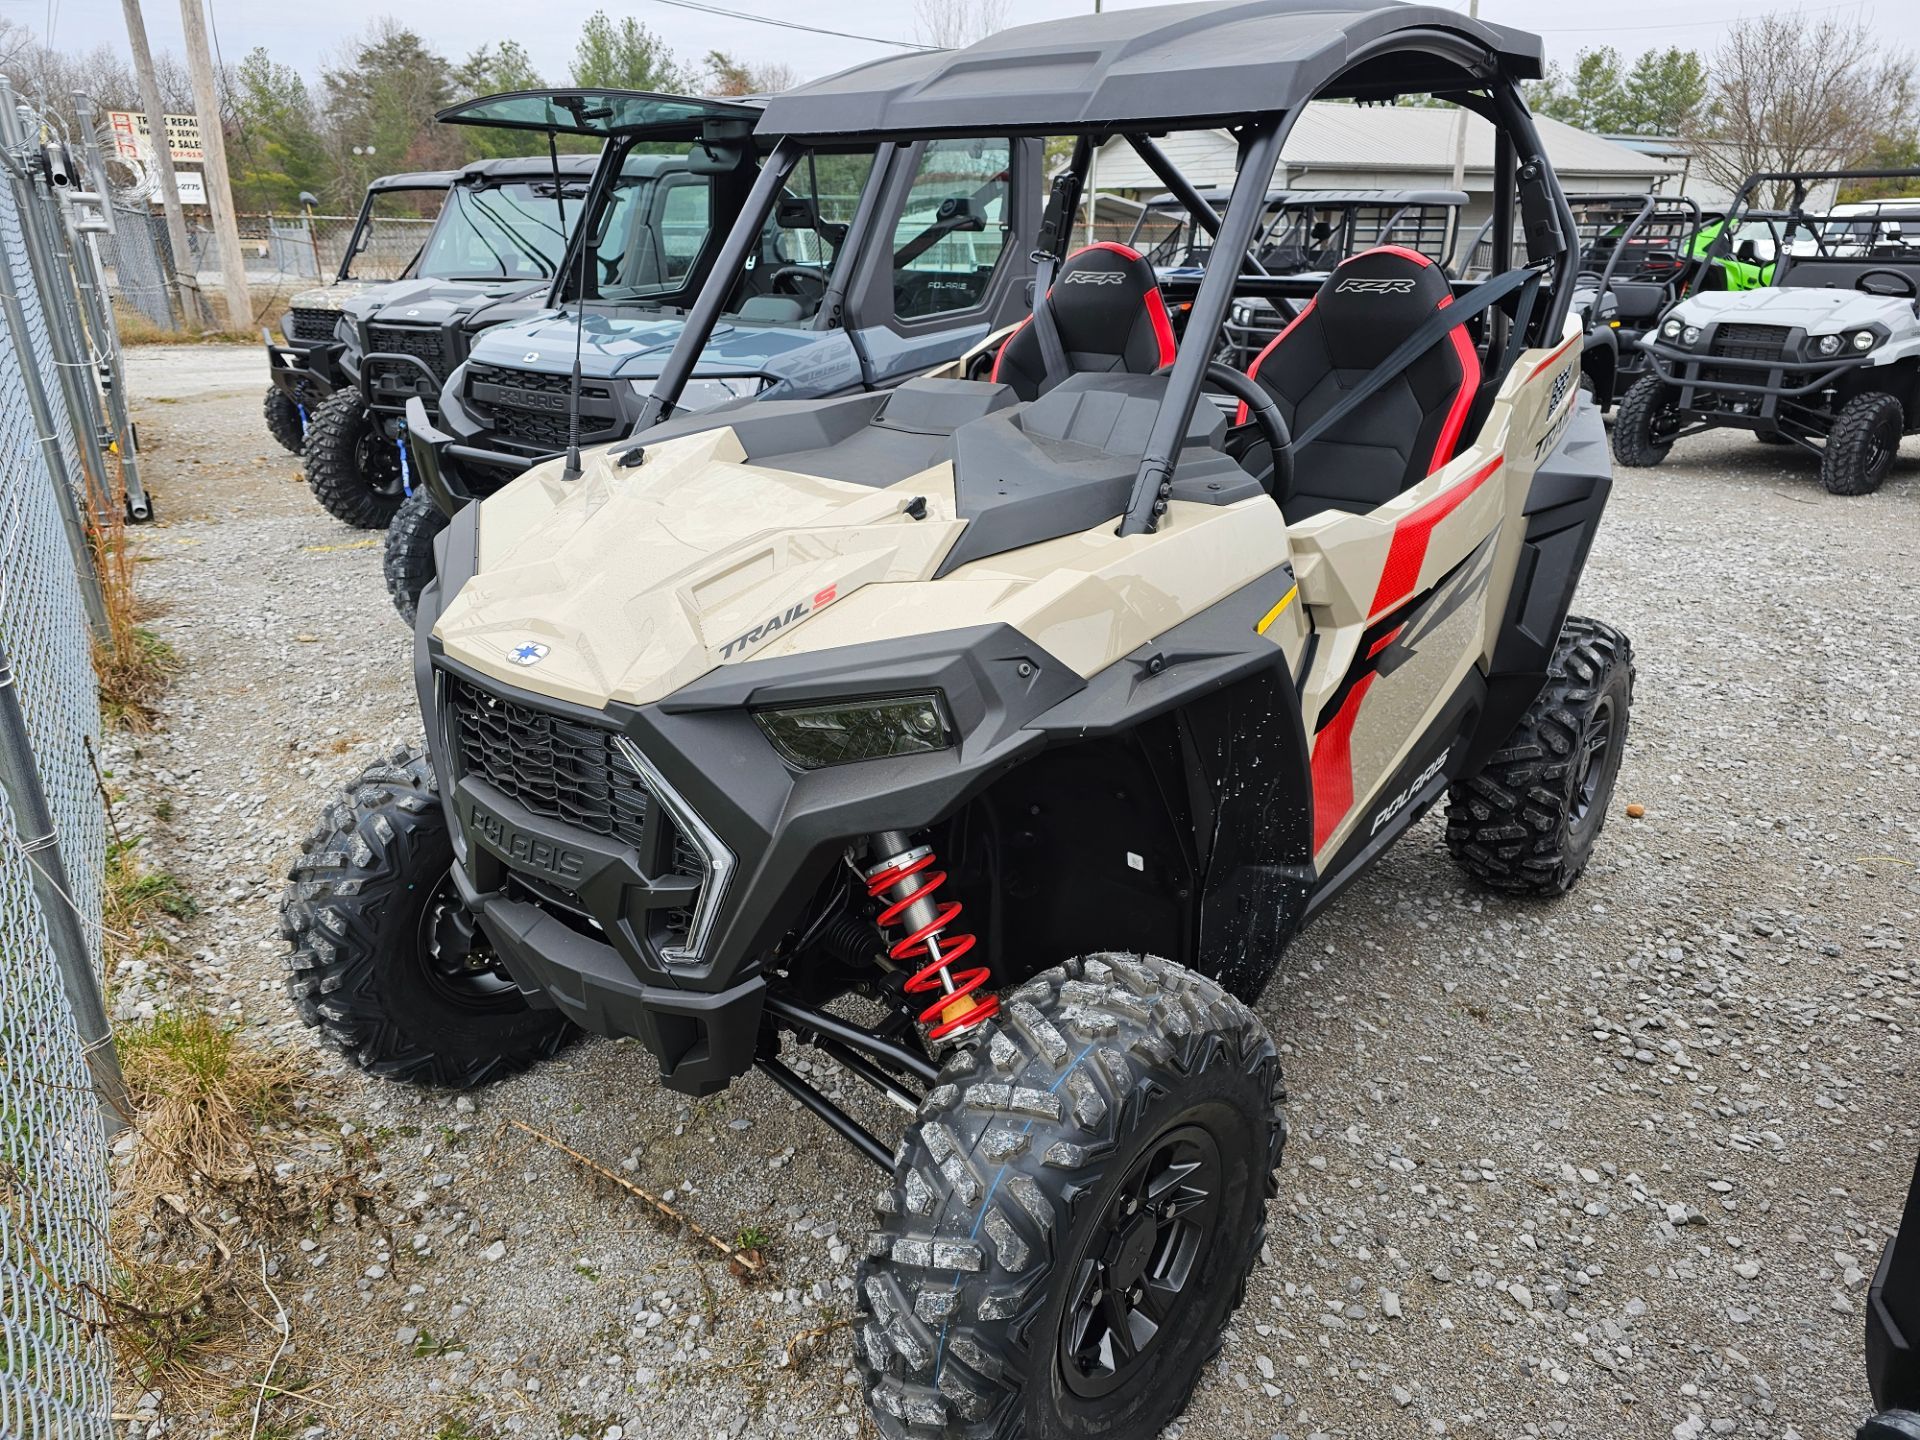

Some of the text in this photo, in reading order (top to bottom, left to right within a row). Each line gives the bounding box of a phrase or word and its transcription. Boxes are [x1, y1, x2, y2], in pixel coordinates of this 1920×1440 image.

[170, 117, 198, 128] REPAI
[927, 281, 967, 290] POLARIS
[1064, 270, 1126, 285] RZR
[1335, 278, 1416, 294] RZR
[499, 389, 565, 412] POLARIS
[719, 583, 838, 660] TRAIL S
[1370, 746, 1450, 837] POLARIS
[470, 804, 584, 881] POLARIS
